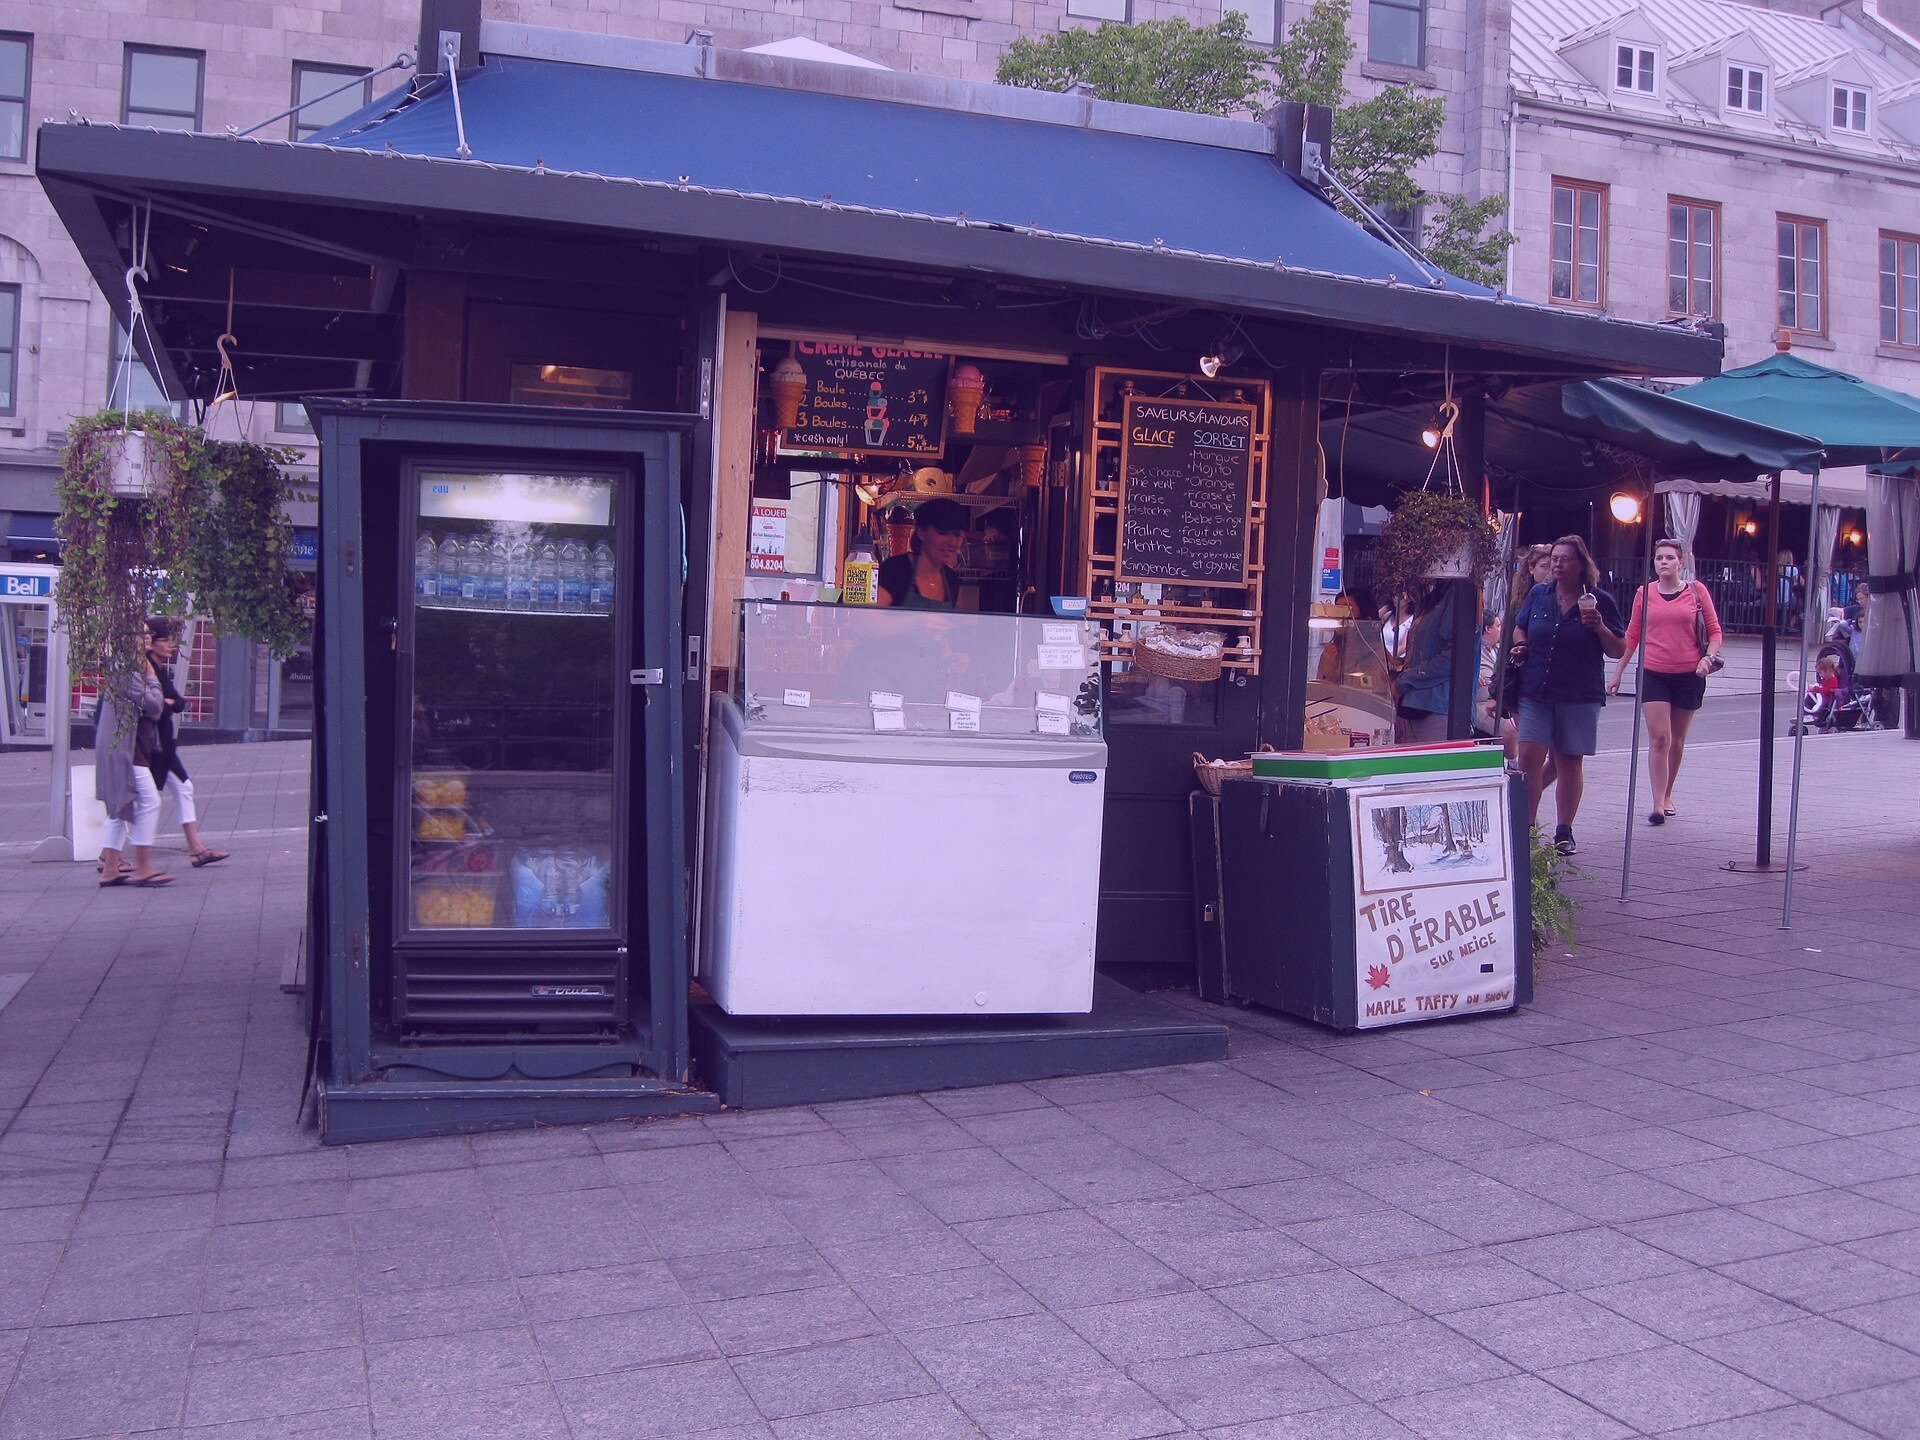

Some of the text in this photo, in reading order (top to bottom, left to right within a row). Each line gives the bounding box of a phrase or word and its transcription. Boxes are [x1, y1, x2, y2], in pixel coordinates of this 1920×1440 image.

[895, 359, 906, 370] du
[834, 369, 884, 381] QUÉBEC
[816, 380, 846, 394] Boule
[796, 411, 808, 427] 3
[1132, 426, 1176, 445] GLACE
[1193, 429, 1246, 449] SORBET
[1193, 450, 1240, 465] Mangue
[1192, 461, 1232, 477] Mojito
[1189, 476, 1235, 491] Orange
[1226, 491, 1236, 501] et
[760, 508, 786, 517] LOUER
[1126, 519, 1172, 538] Praline
[1212, 527, 1224, 536] de
[1226, 527, 1238, 536] la
[1125, 539, 1173, 554] Menthe
[750, 558, 783, 570] 804.8204
[1123, 556, 1190, 577] Gingembre
[1192, 559, 1204, 569] et
[7, 577, 39, 595] Bell
[1429, 949, 1455, 970] SUR
[1365, 991, 1511, 1017] MAPLE TAFFY ON SNOW
